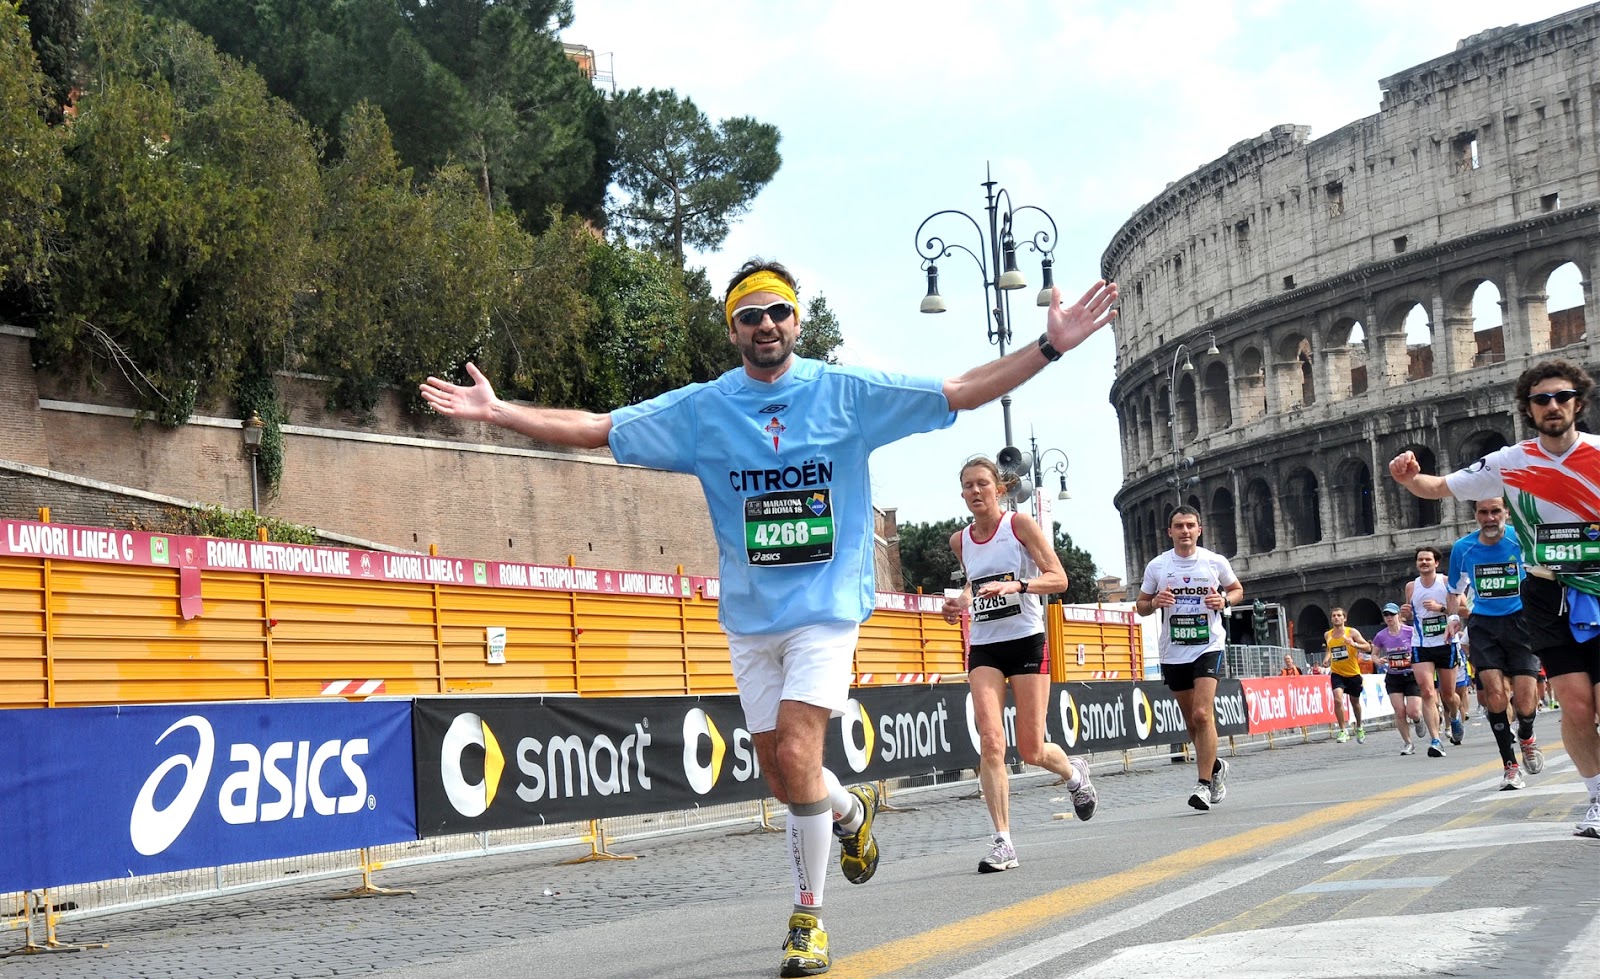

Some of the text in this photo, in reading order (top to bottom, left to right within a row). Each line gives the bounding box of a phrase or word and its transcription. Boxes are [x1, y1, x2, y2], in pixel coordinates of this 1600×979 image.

[730, 460, 832, 492] CITROËN
[762, 499, 802, 508] MARATONA
[772, 506, 793, 515] ROMA
[7, 523, 134, 561] LAVORI LINEA C
[755, 521, 809, 546] 4268
[206, 541, 351, 575] ROMA METROPOLITANE
[760, 553, 780, 561] asics
[1545, 544, 1582, 560] 5811
[383, 555, 464, 583] LAVORI LINEA C
[499, 564, 599, 591] ROMA METROPOLITANE
[618, 573, 674, 595] LAVORI LINEA C
[1196, 586, 1209, 596] 85
[1480, 577, 1505, 590] 4297
[979, 595, 1007, 611] 3285
[1174, 627, 1198, 639] 5876
[1256, 688, 1287, 721] UniCredit
[1294, 685, 1323, 717] UniCredit
[1080, 696, 1127, 742] smart
[1154, 698, 1187, 734] sma
[880, 702, 951, 762] smart
[515, 723, 652, 803] smart
[219, 738, 370, 825] asics
